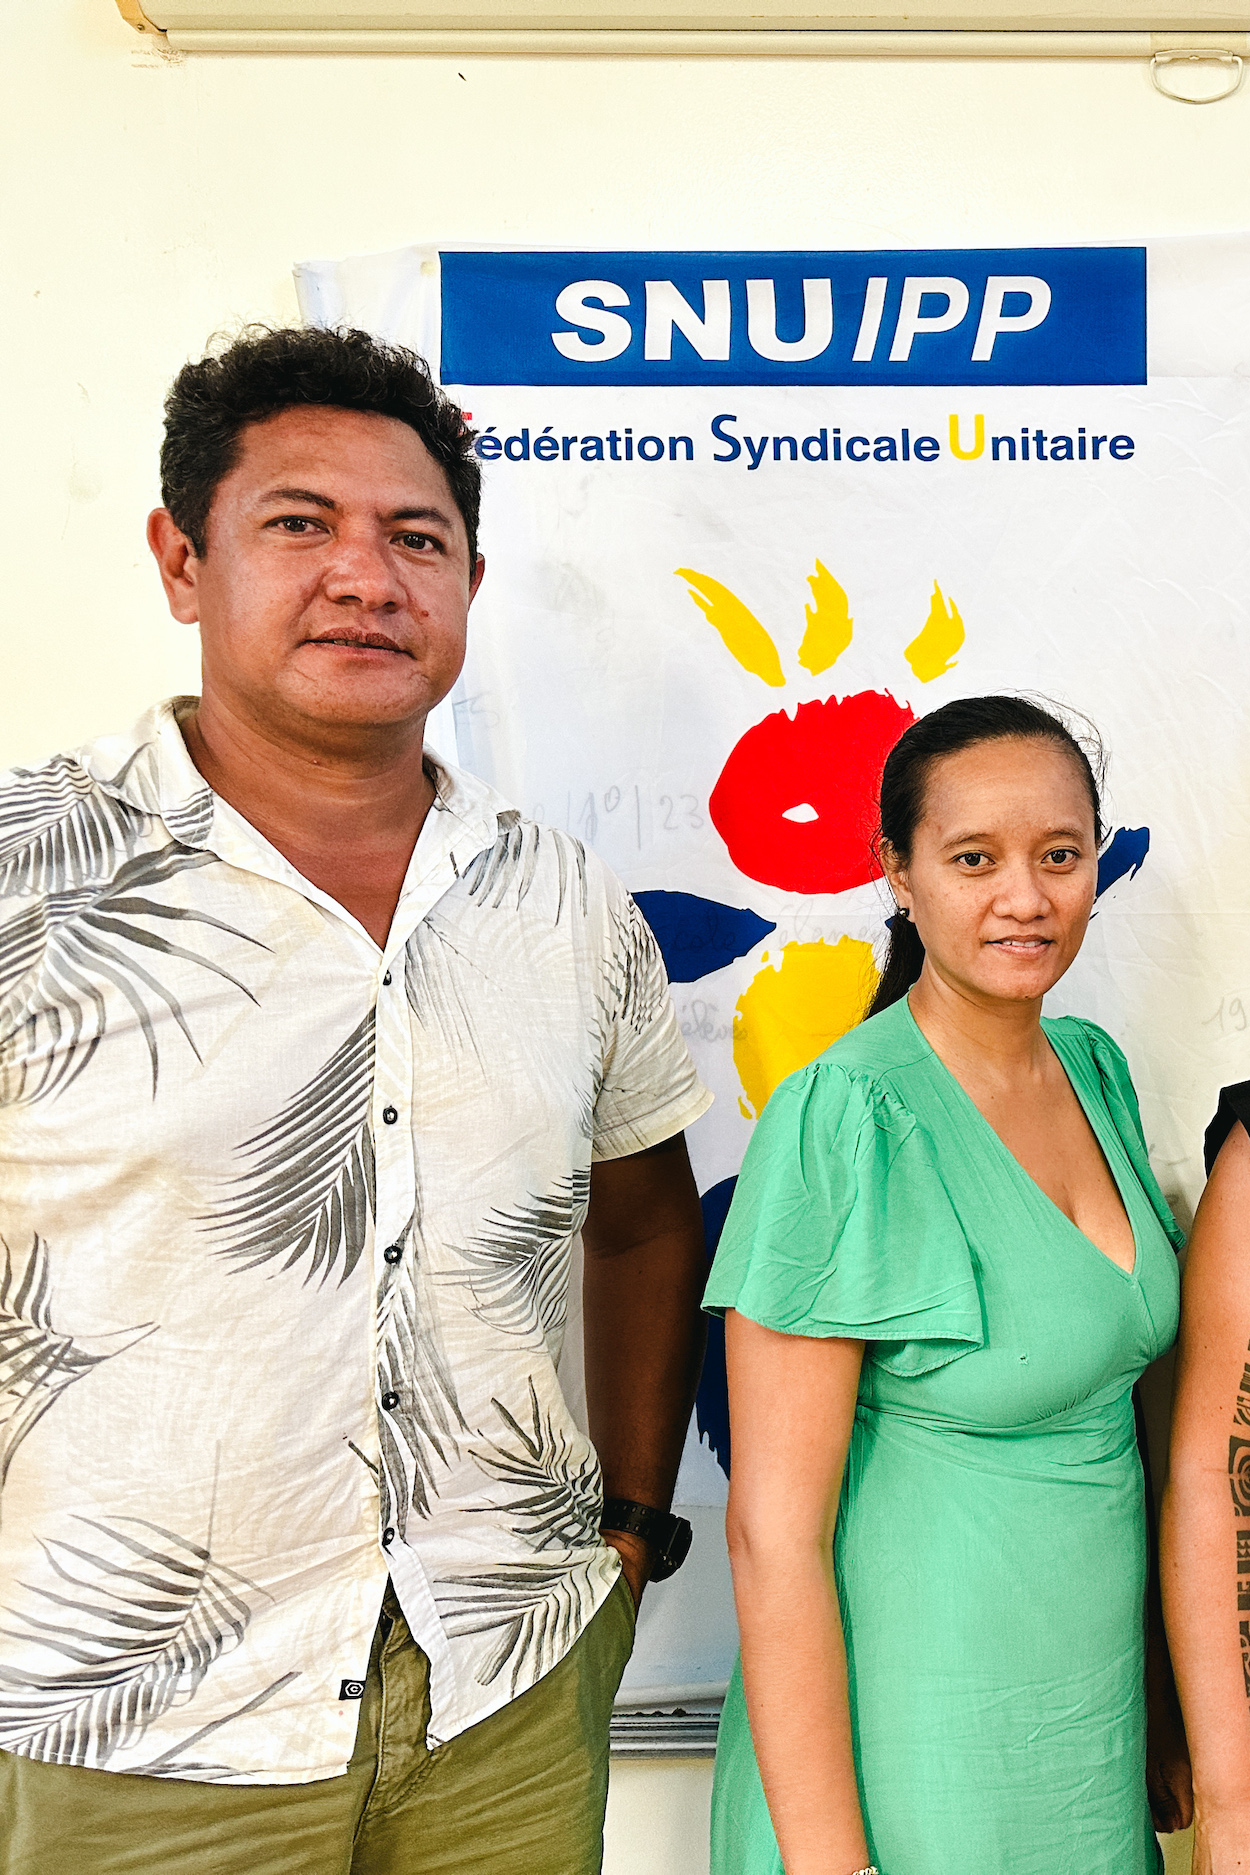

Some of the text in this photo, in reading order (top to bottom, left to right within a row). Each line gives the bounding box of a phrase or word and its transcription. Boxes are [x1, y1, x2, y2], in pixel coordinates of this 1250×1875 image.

[461, 412, 1134, 470] édération Syndicale Unitaire
[1201, 997, 1248, 1032] 19
